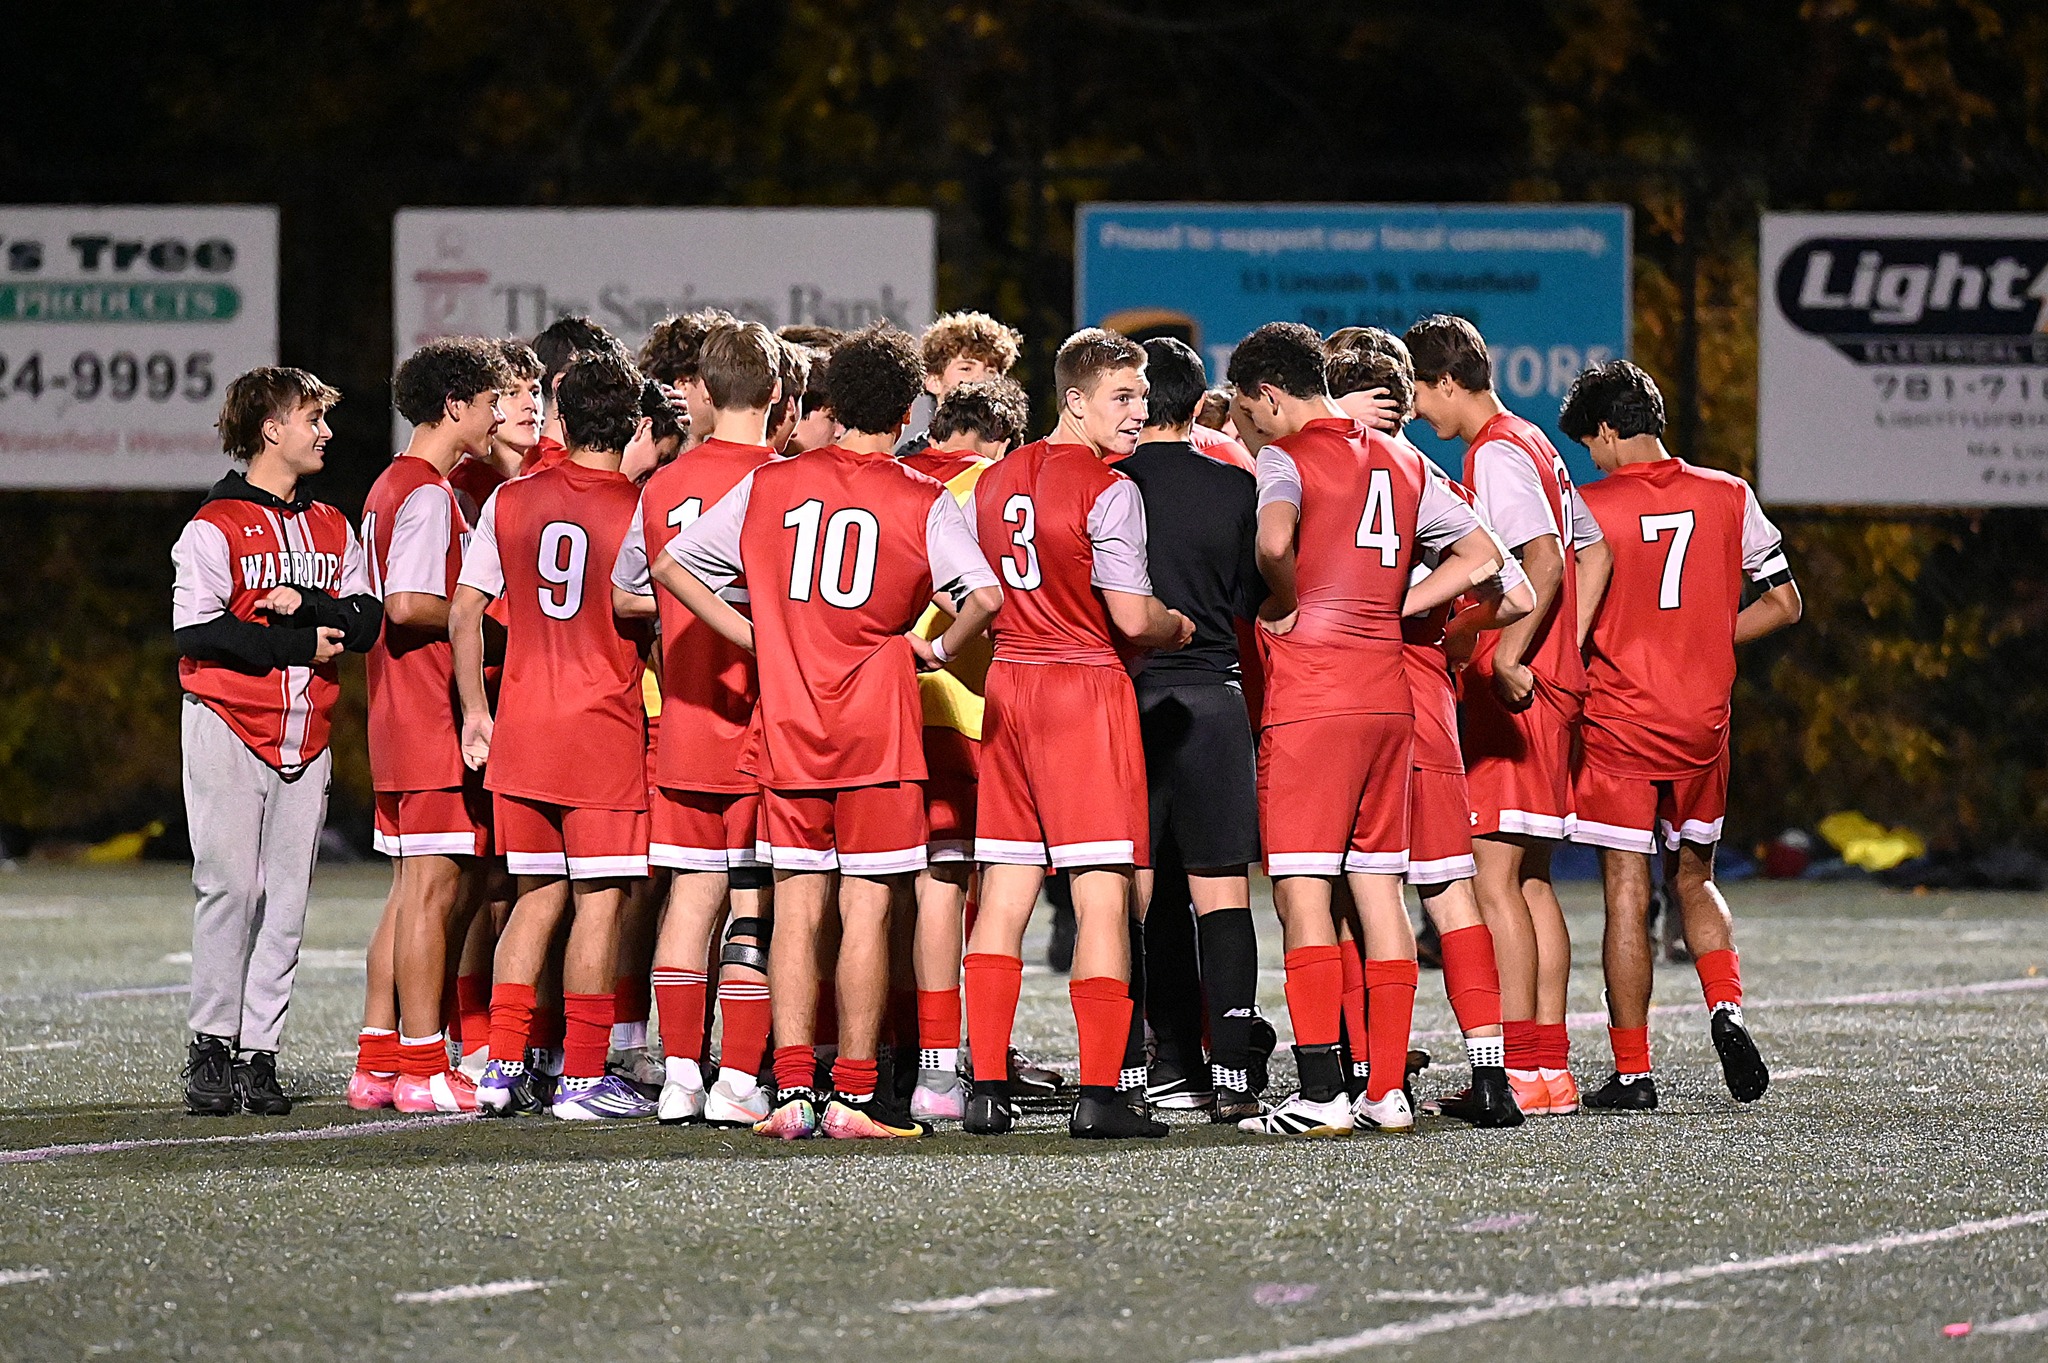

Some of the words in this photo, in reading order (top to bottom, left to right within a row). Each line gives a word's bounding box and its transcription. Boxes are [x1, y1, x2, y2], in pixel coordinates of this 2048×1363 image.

[68, 232, 237, 273] Tree
[1100, 223, 1181, 250] Proud
[1186, 225, 1213, 250] to
[1218, 226, 1325, 257] support
[1328, 230, 1376, 250] our
[1380, 224, 1446, 250] local
[1800, 250, 2029, 324] Light
[15, 286, 218, 316] PRODUCTS
[783, 498, 880, 610] 10
[1000, 494, 1042, 591] 3
[1355, 469, 1400, 568] 4
[1639, 509, 1695, 610] 7
[537, 520, 589, 621] 9
